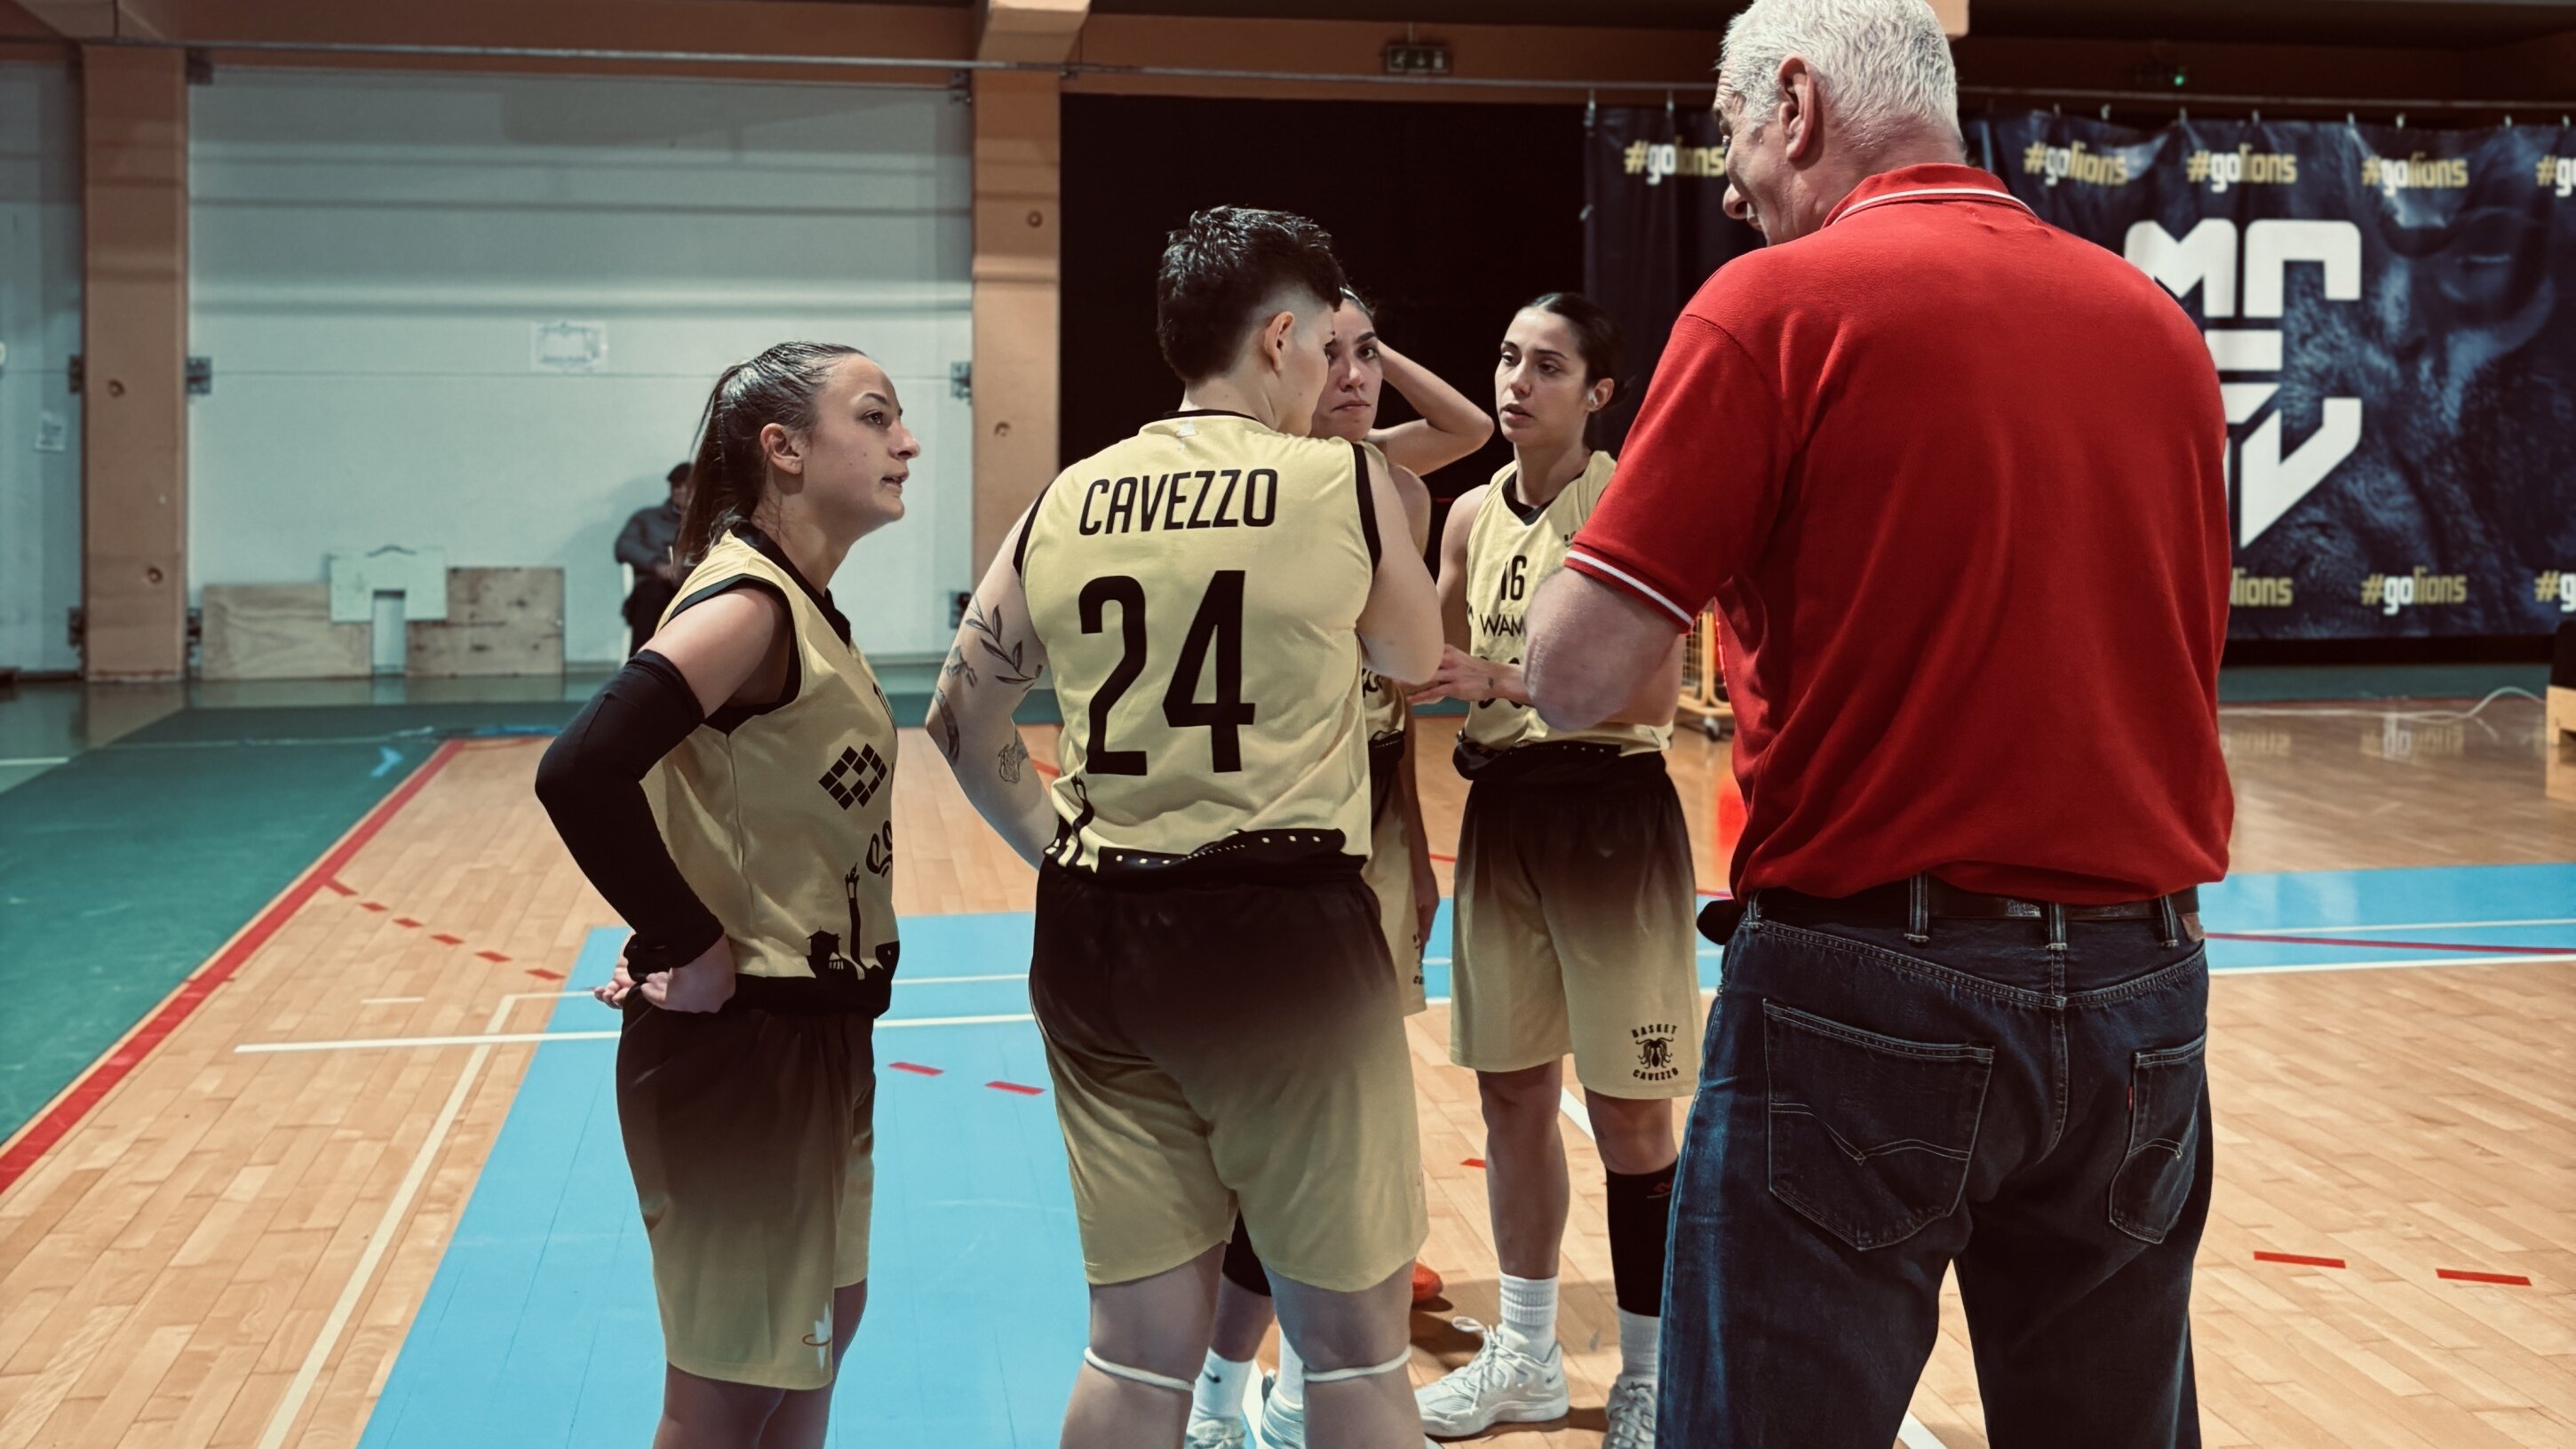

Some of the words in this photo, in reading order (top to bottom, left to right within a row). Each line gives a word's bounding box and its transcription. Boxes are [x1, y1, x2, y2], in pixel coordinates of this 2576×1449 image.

[2024, 139, 2128, 187] #golions
[2362, 150, 2469, 197] #golions
[1078, 468, 1279, 537] CAVEZZO
[1500, 555, 1528, 601] 16
[2360, 566, 2468, 615] #golions
[1077, 569, 1257, 776] 24
